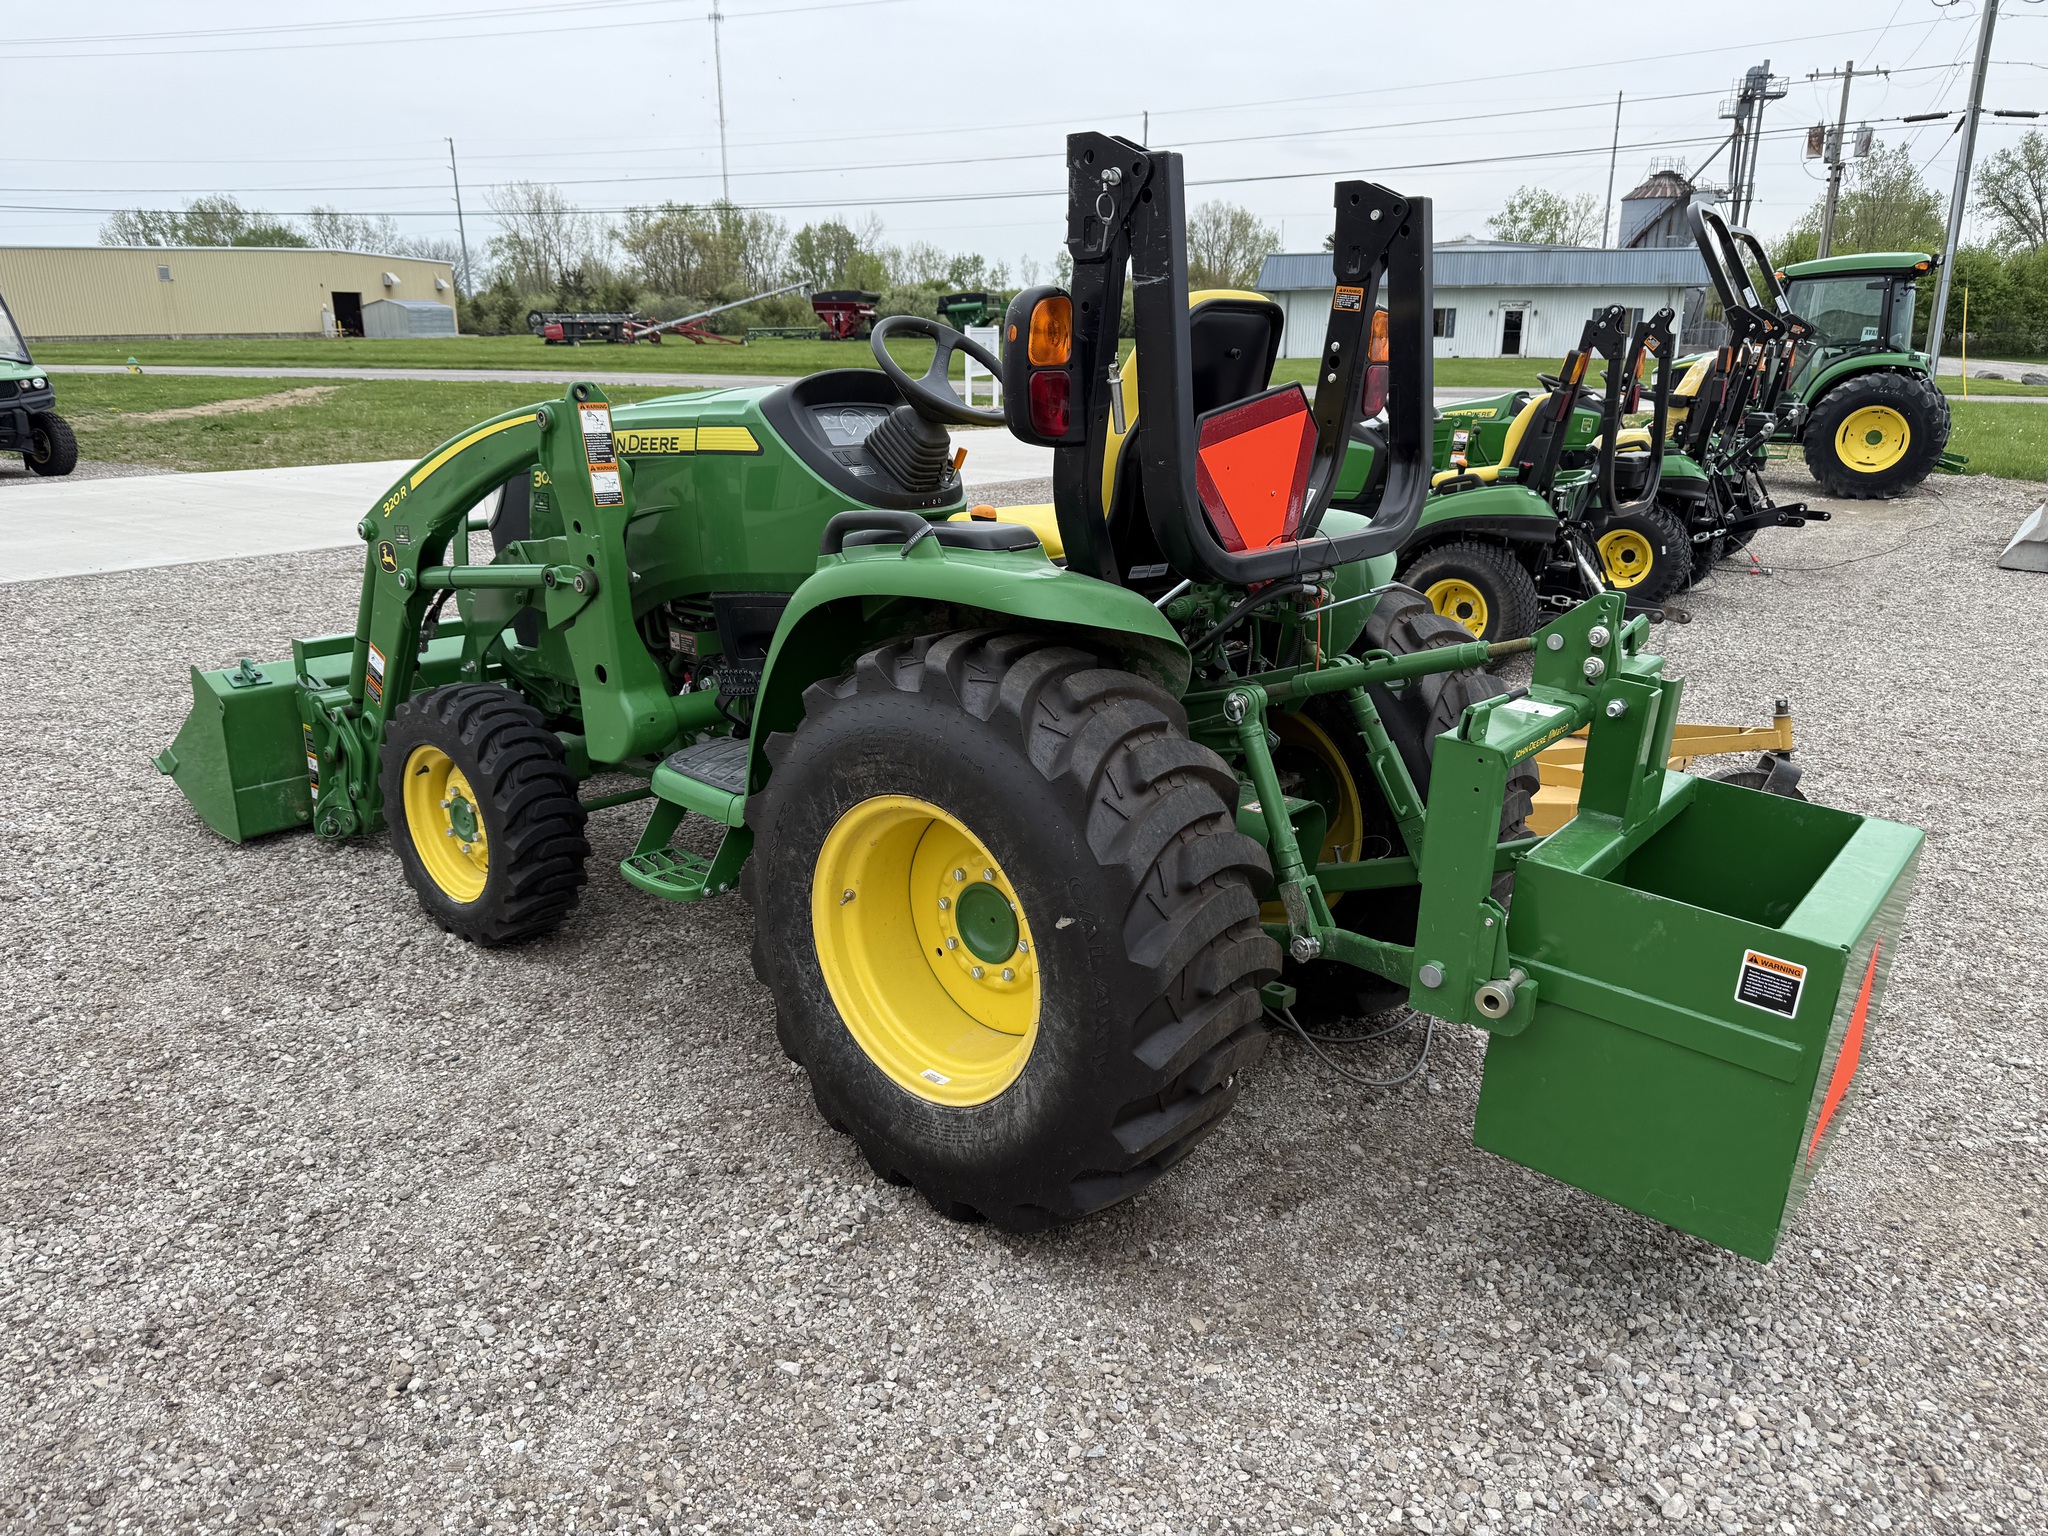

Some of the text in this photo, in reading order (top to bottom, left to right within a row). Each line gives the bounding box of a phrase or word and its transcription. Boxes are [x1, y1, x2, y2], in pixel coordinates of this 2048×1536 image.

[628, 434, 680, 451] DEERE
[533, 470, 553, 488] 30
[1761, 959, 1801, 977] WARNING
